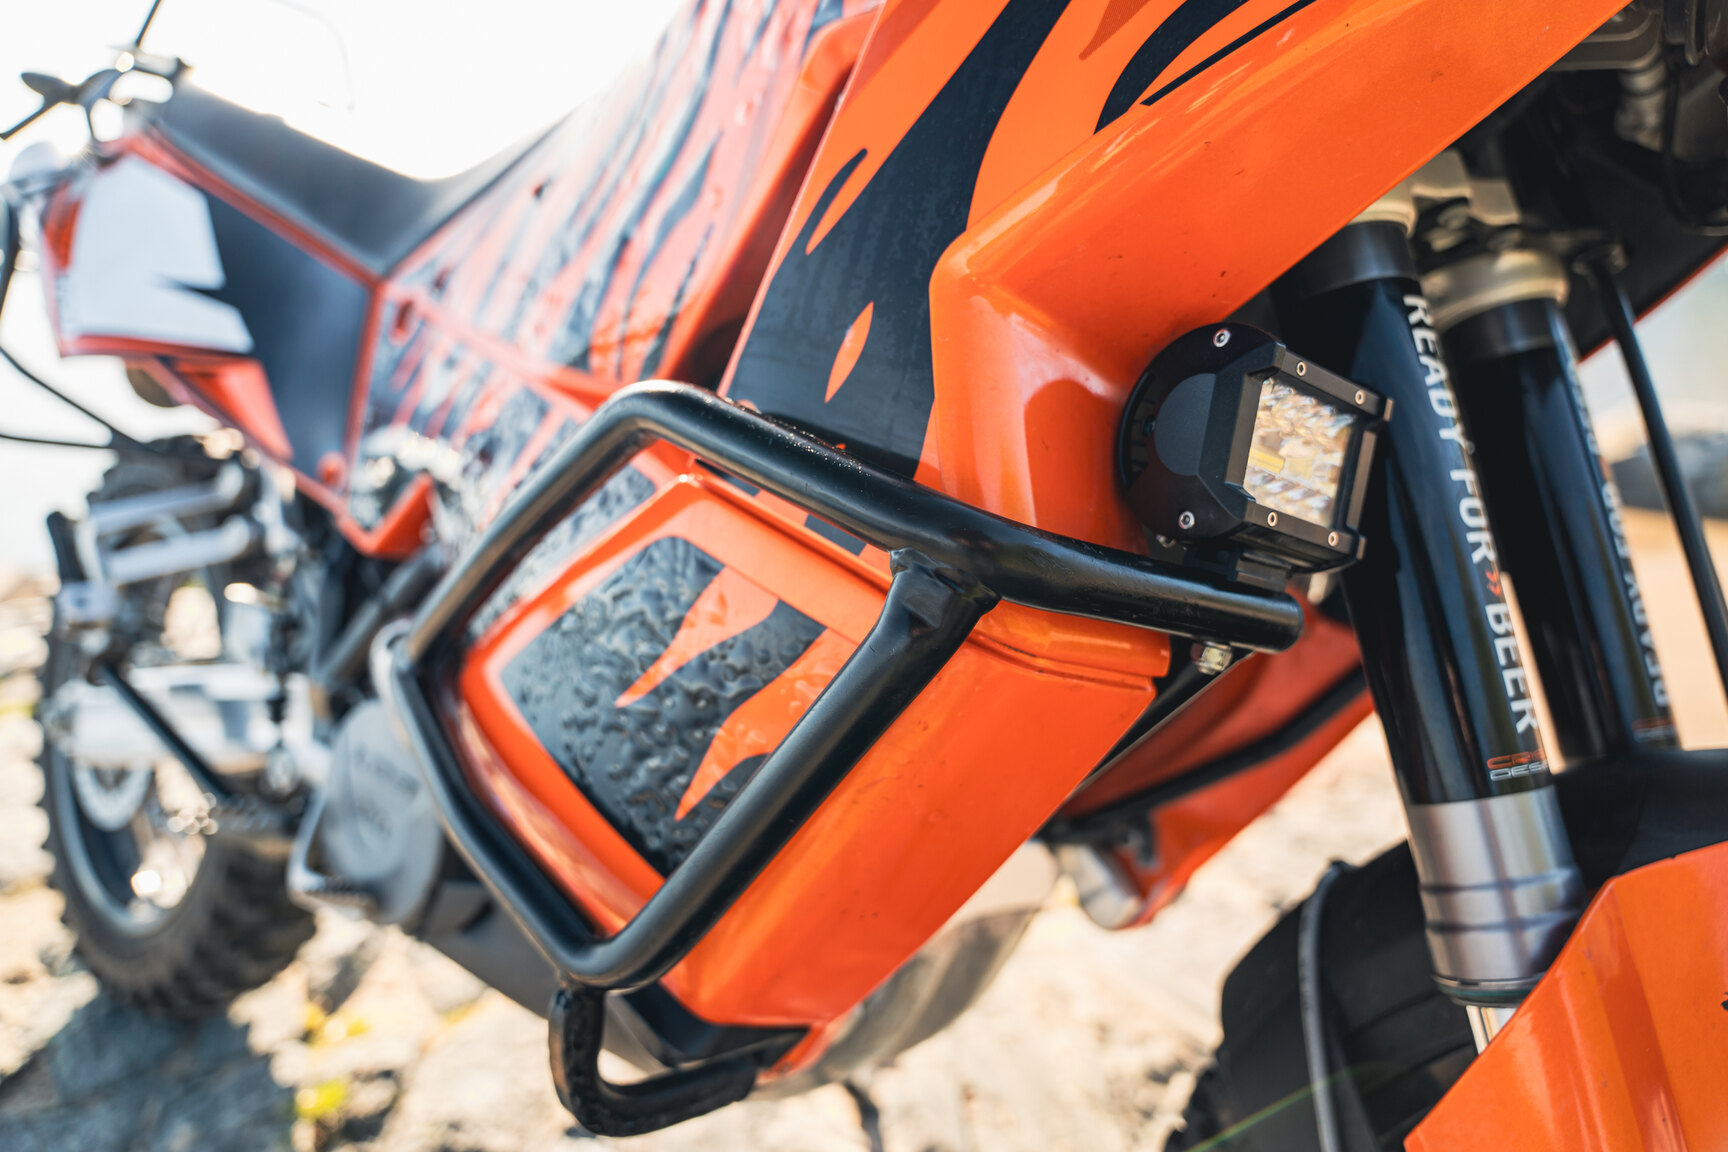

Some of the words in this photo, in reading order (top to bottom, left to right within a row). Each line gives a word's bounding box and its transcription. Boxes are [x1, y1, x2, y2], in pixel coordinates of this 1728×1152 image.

[1403, 294, 1465, 449] READY
[1450, 469, 1496, 564] FOR
[1485, 603, 1539, 734] BEER
